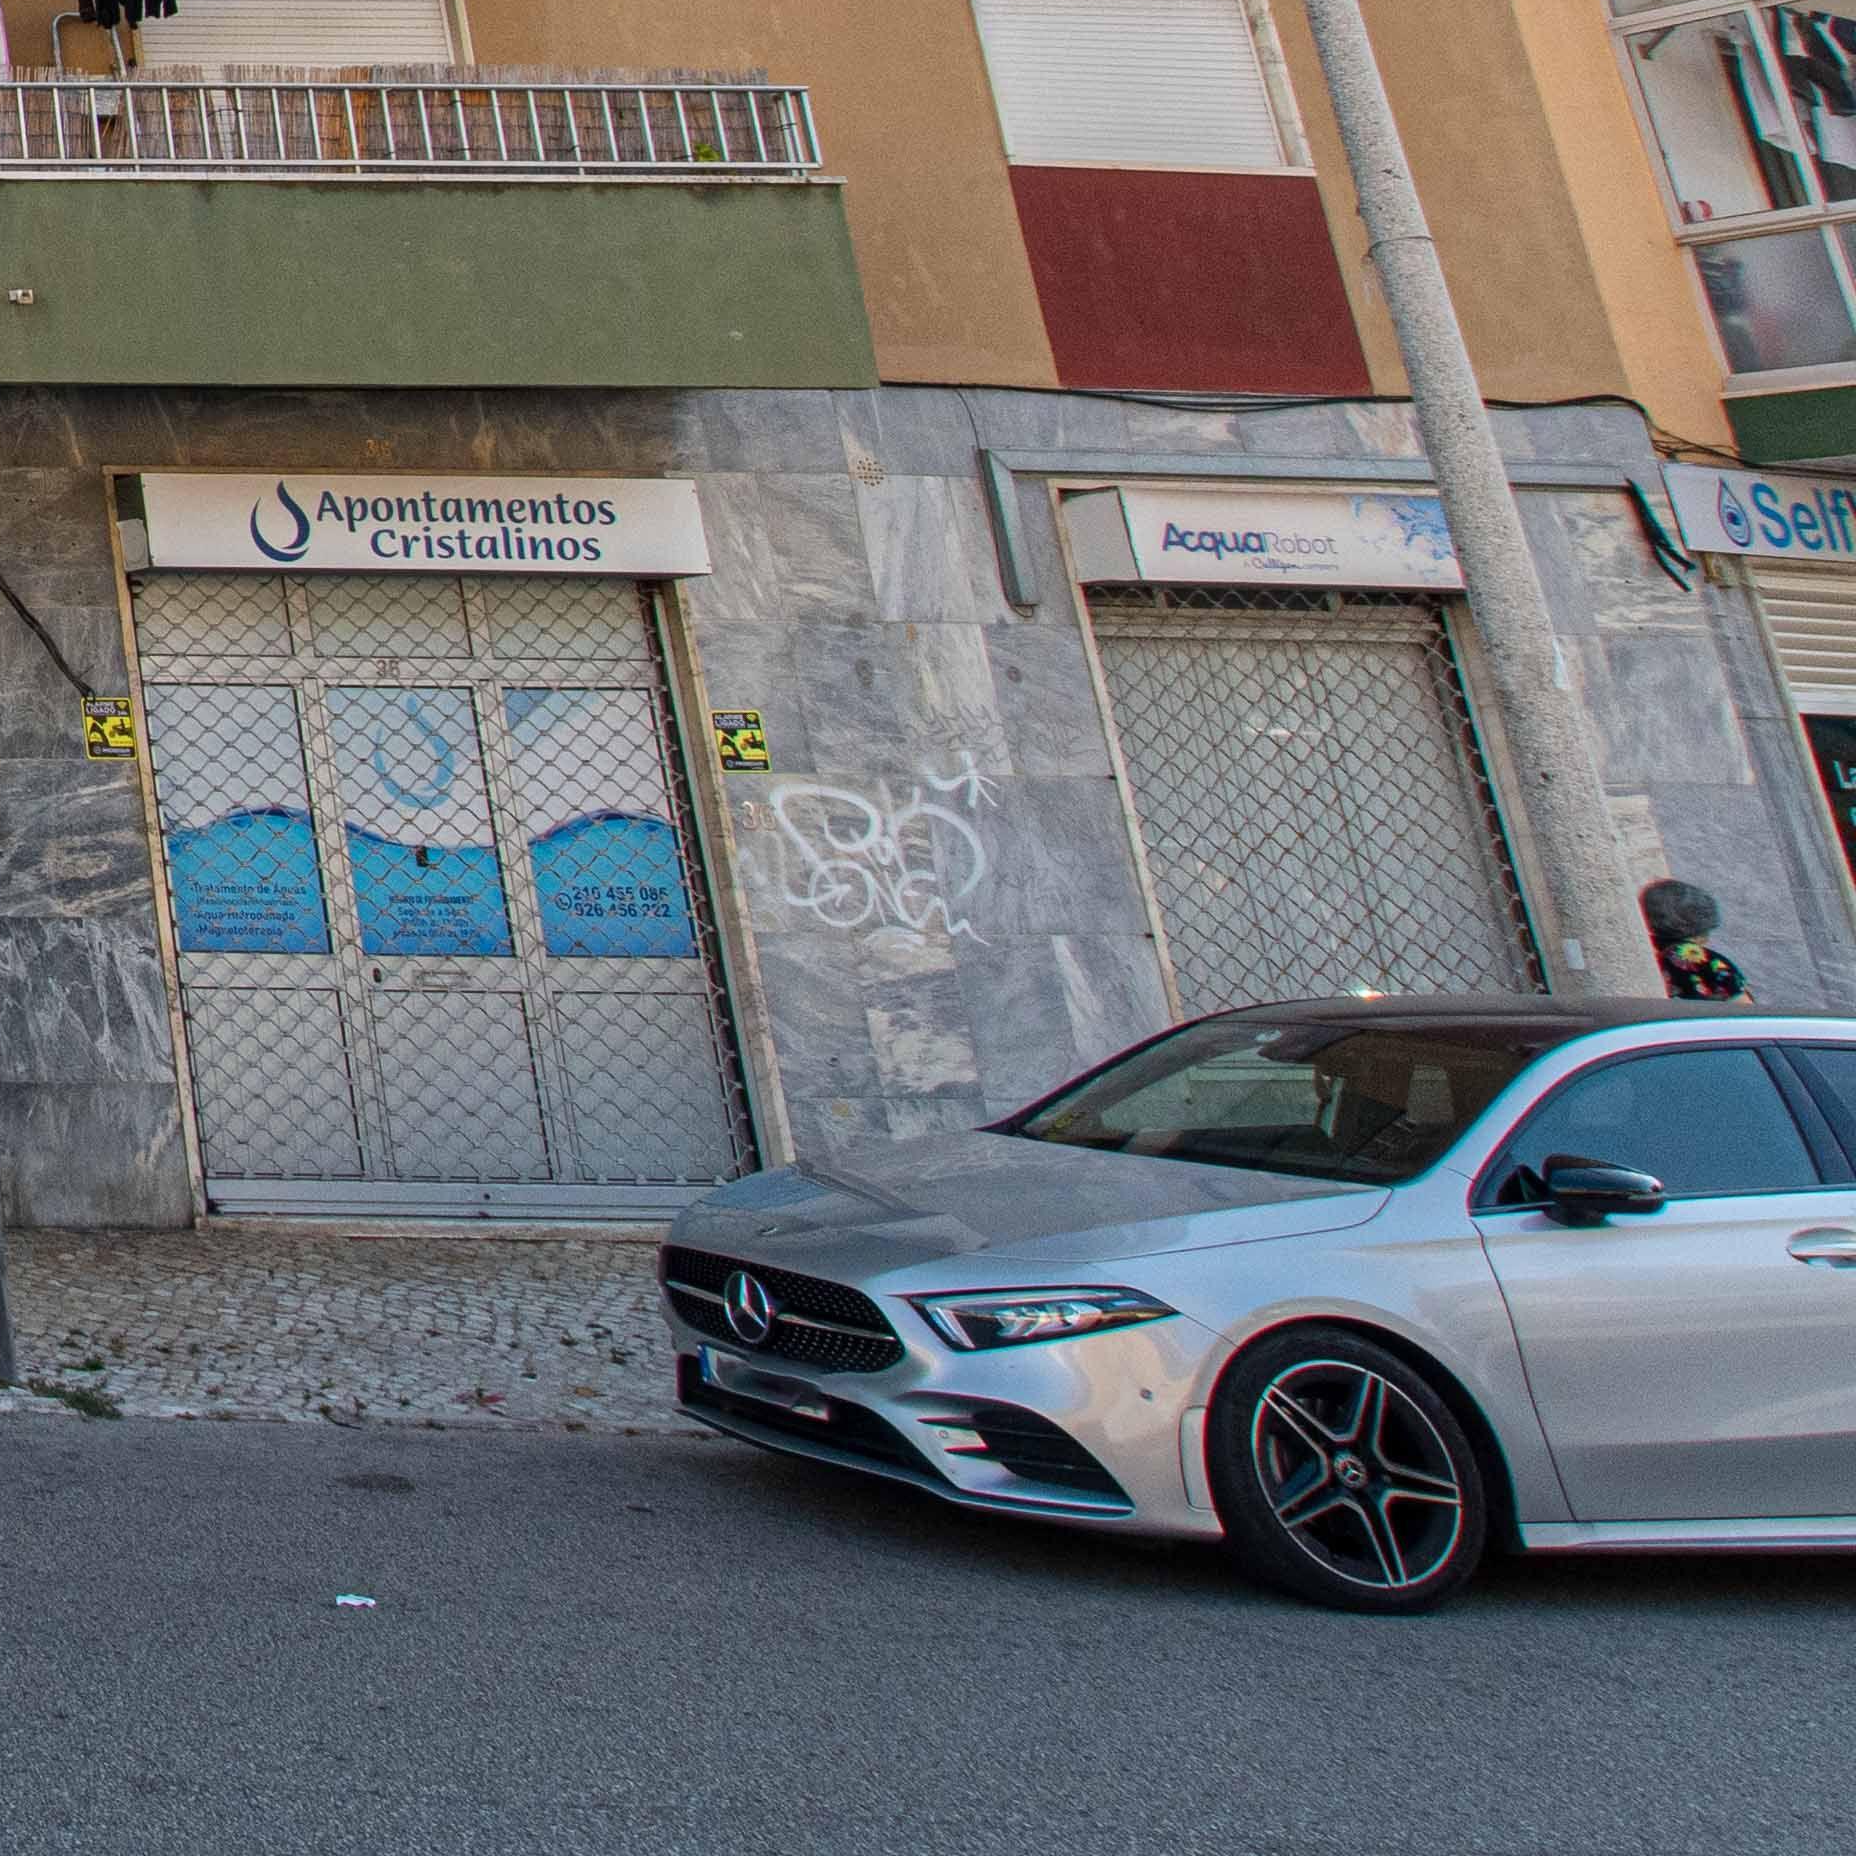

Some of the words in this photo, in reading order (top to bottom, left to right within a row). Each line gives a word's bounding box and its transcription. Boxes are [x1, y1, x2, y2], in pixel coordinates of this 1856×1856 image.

[316, 490, 616, 533] Apontamentos
[1750, 482, 1856, 553] Self
[370, 526, 602, 561] Cristalinos
[1162, 521, 1340, 561] AcquaRobot
